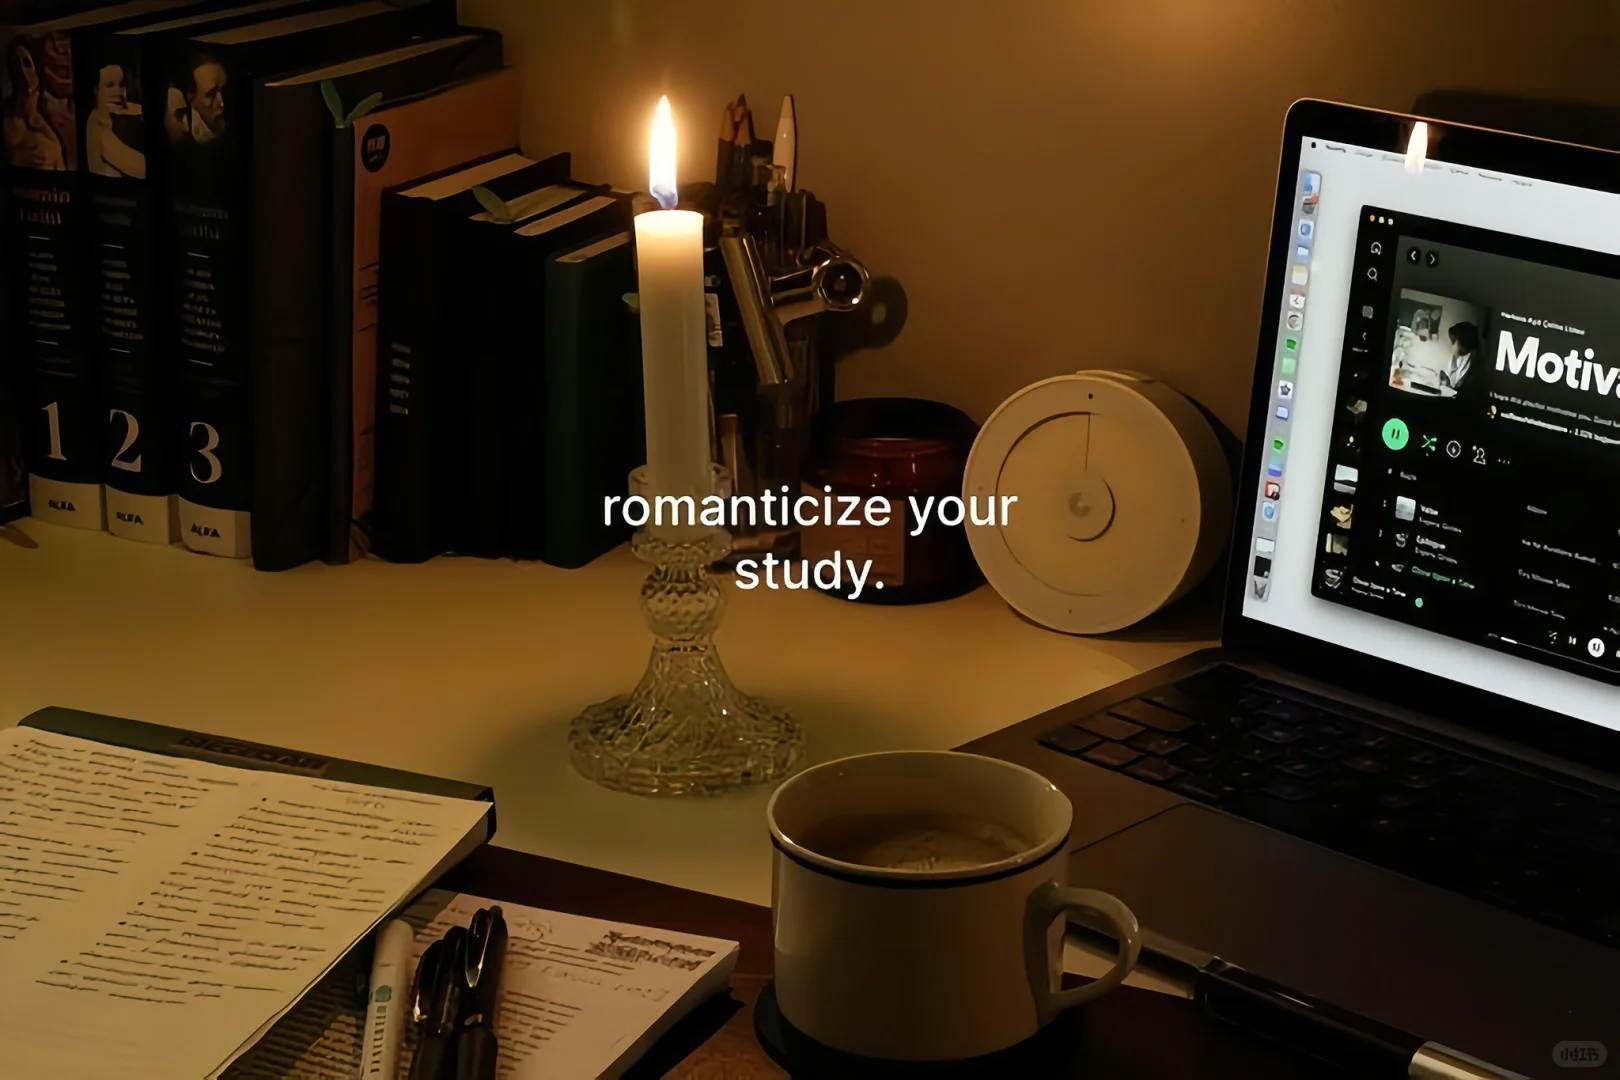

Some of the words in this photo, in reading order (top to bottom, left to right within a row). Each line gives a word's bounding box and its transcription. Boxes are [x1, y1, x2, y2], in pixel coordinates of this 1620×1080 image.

[1495, 330, 1620, 399] Motiv
[41, 401, 68, 461] 1
[109, 408, 143, 473] 2
[189, 421, 222, 484] 3
